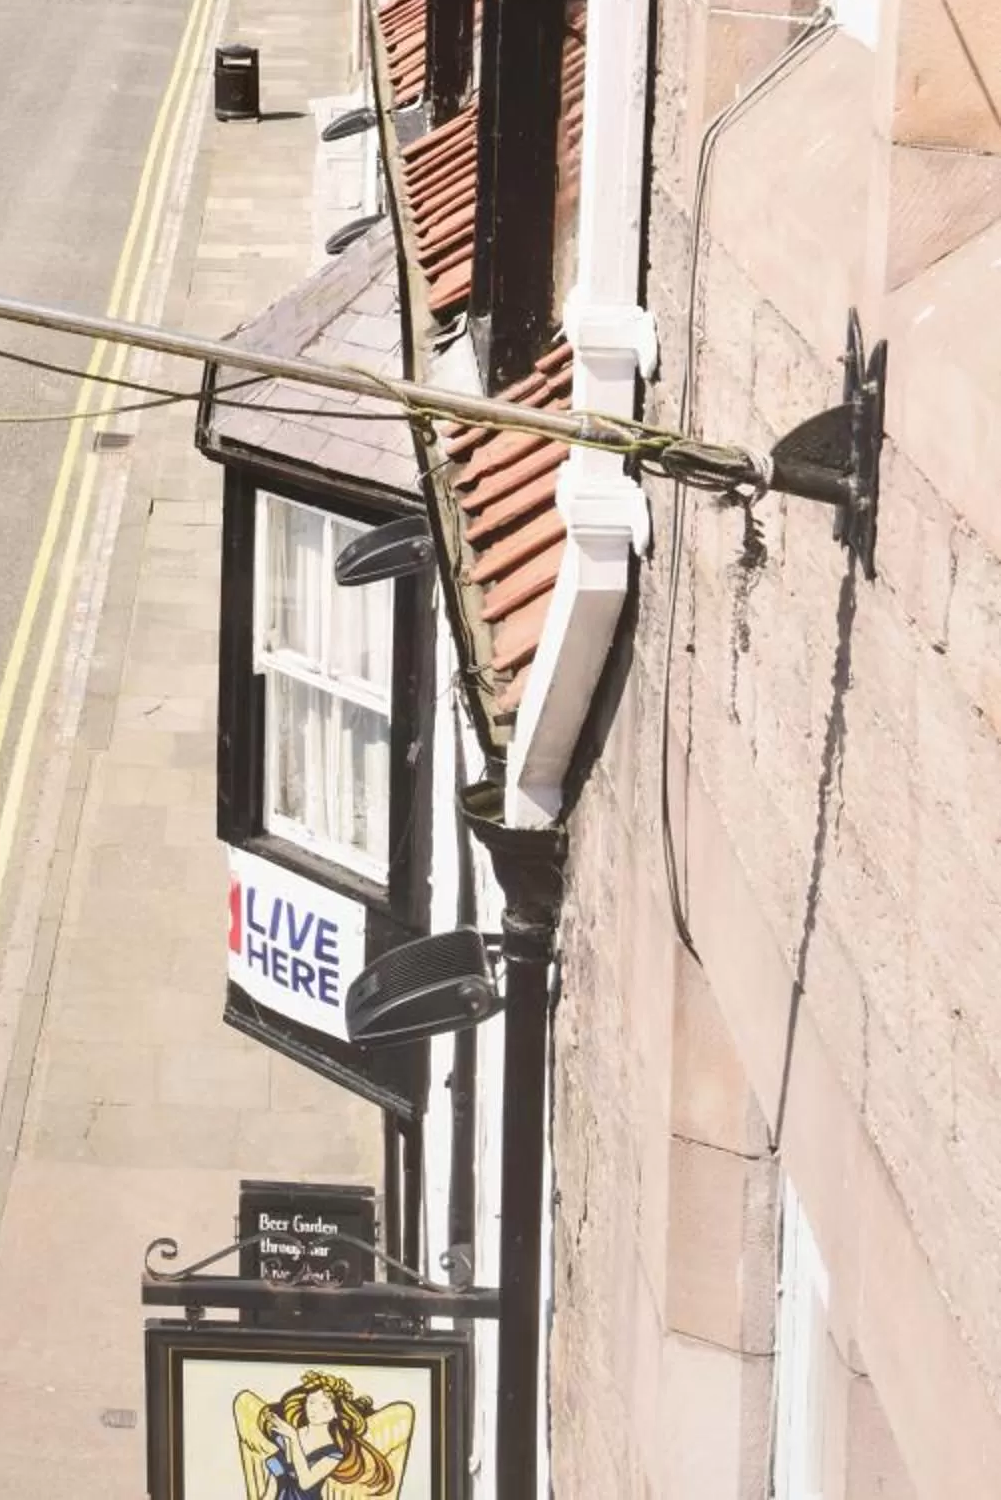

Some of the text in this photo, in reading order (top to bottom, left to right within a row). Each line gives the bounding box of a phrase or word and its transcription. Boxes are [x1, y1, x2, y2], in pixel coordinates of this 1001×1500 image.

[246, 886, 340, 966] LIVE
[246, 933, 340, 1008] HERE
[258, 1212, 339, 1236] Beer Garden
